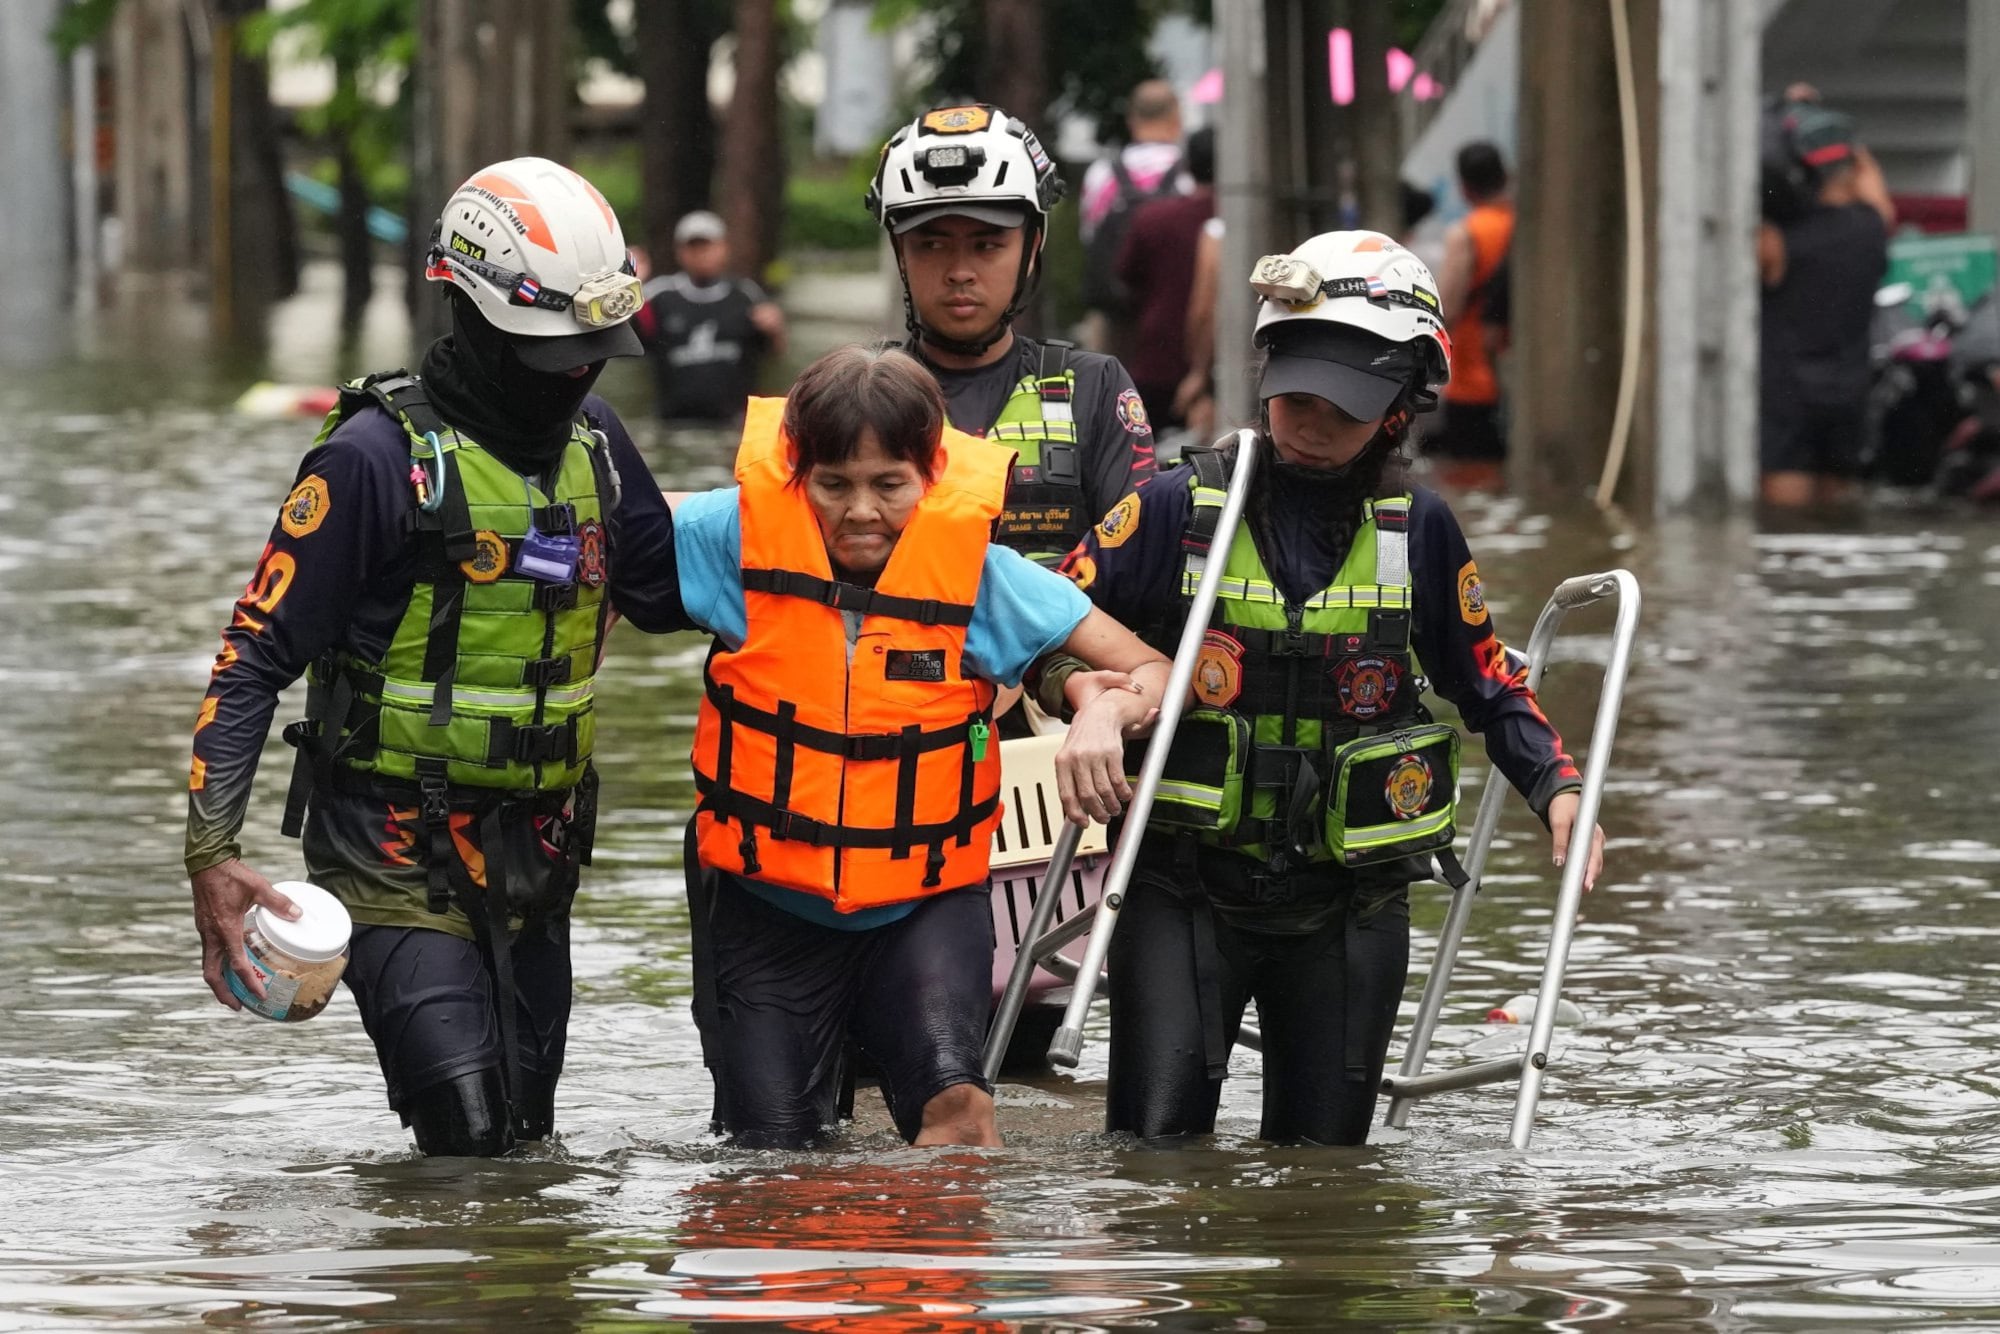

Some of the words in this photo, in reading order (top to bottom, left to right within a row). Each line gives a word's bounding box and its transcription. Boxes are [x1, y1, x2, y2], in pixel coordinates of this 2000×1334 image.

[470, 246, 482, 260] 14
[912, 653, 930, 661] THE
[911, 661, 941, 669] GRAND
[910, 669, 940, 677] ZEBRA
